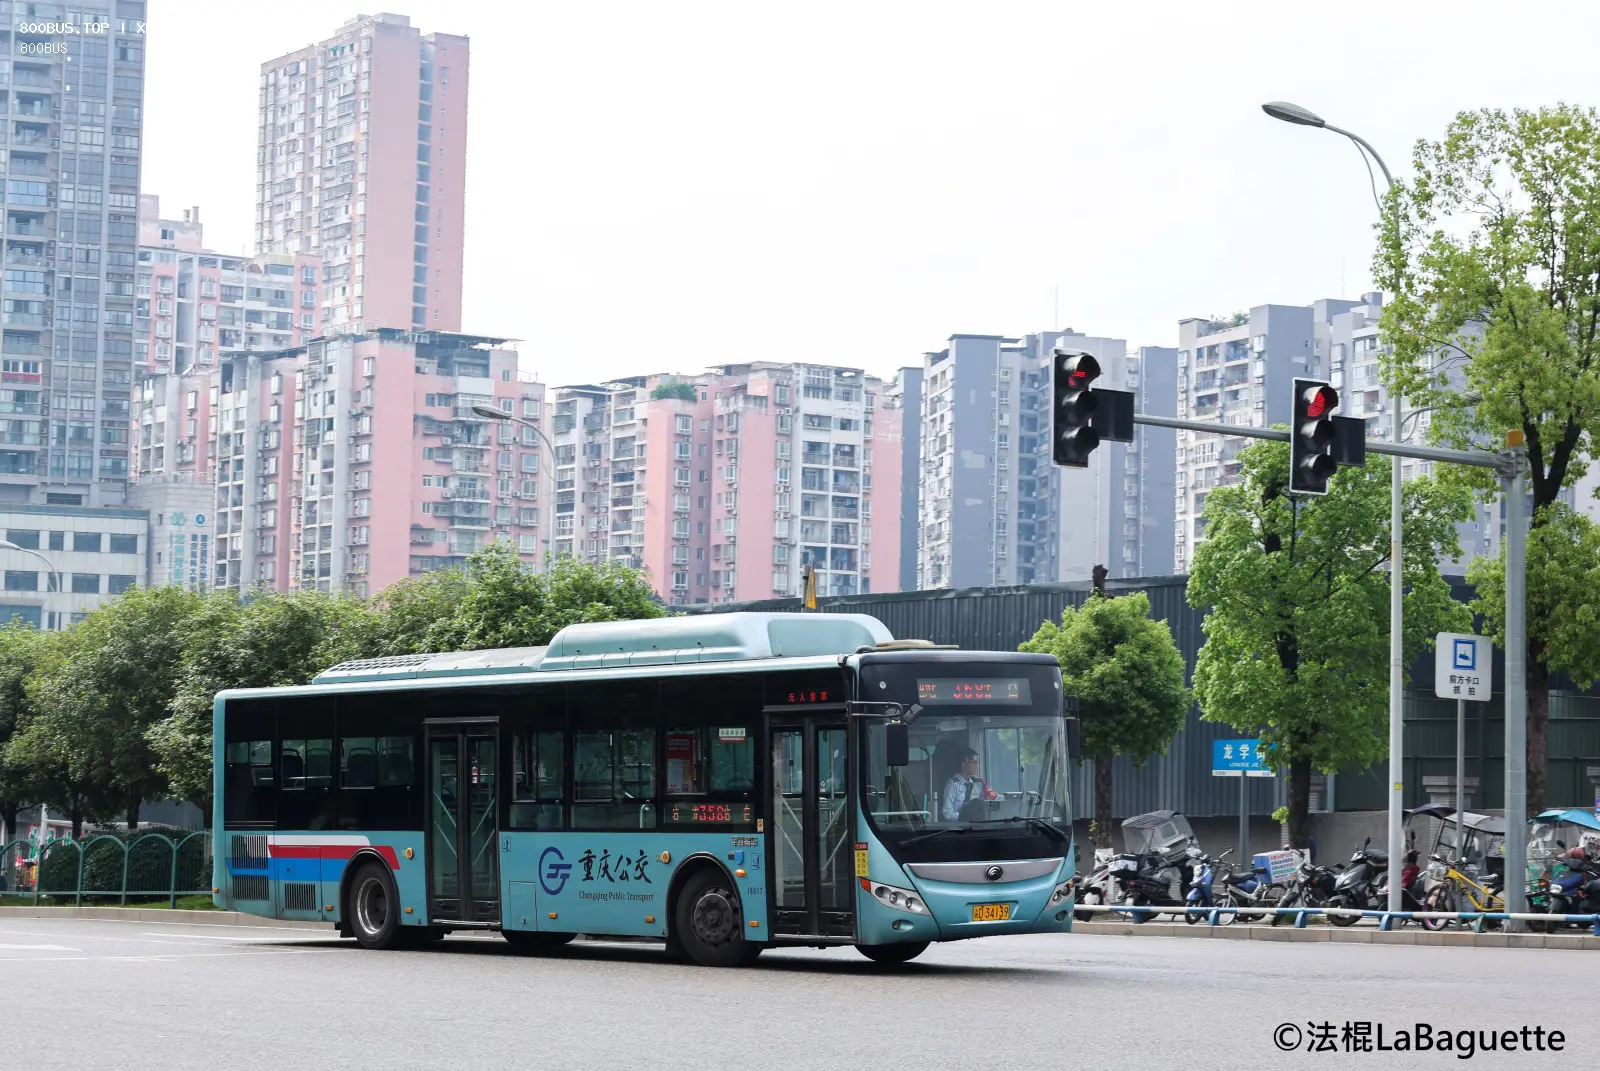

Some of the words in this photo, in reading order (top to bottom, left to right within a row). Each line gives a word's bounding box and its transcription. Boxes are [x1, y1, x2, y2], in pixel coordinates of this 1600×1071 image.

[1449, 674, 1480, 686] 前方卡口
[1453, 685, 1476, 696] 抓拍
[578, 848, 653, 884] 重庆公交
[578, 890, 608, 902] Chongqing
[608, 891, 626, 901] Public
[626, 892, 654, 902] Transport
